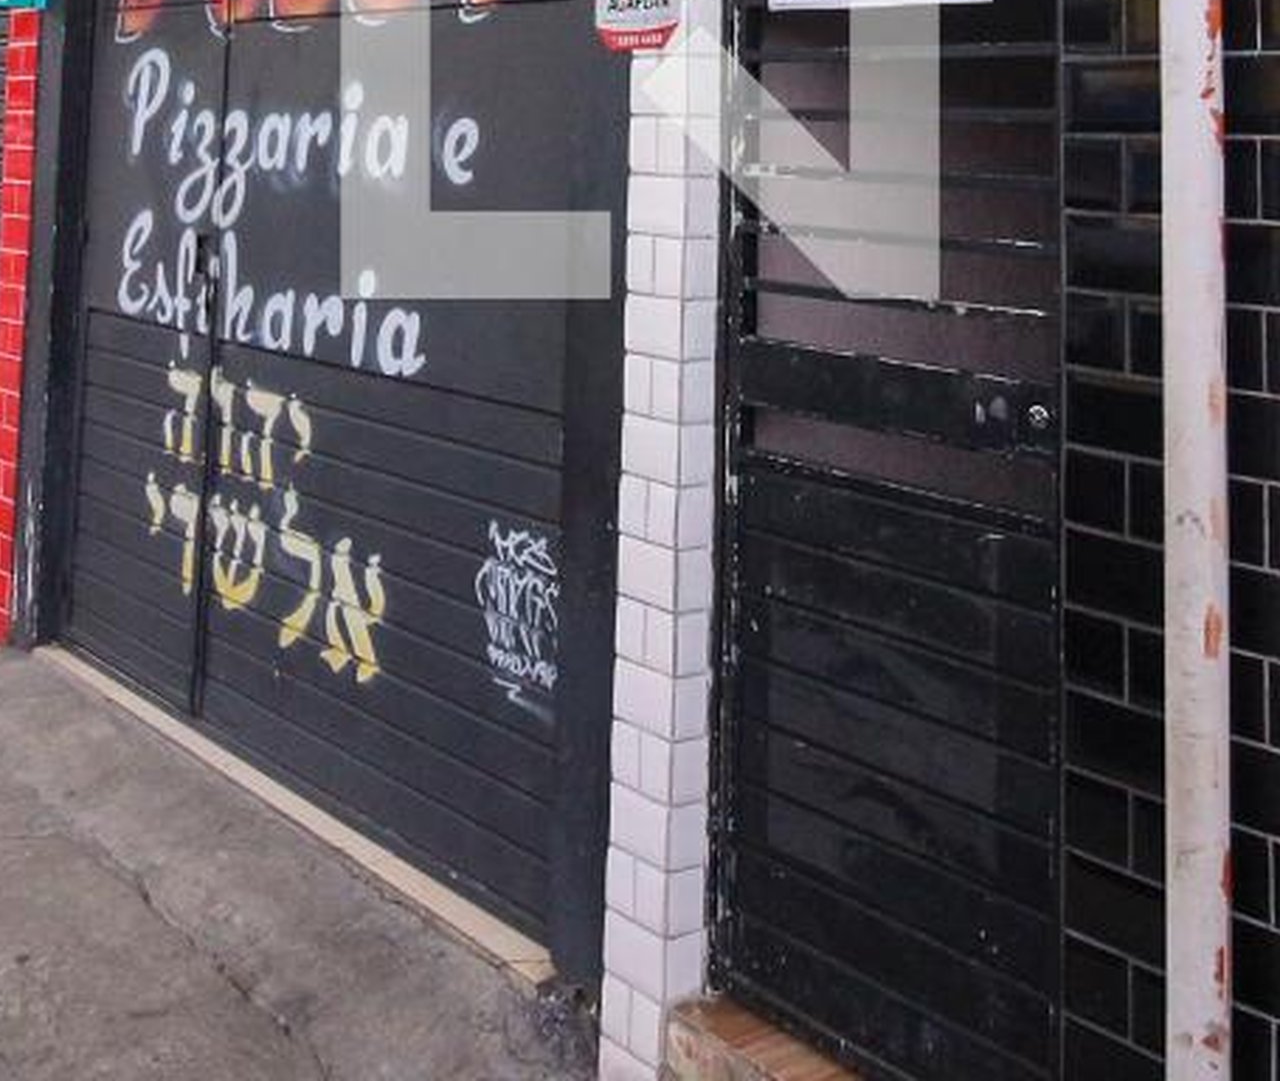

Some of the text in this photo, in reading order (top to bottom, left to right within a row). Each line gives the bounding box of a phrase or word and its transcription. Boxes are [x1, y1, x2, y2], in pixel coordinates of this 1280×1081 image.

[126, 47, 481, 228] Pizzaria e
[118, 208, 427, 377] Esfiharia
